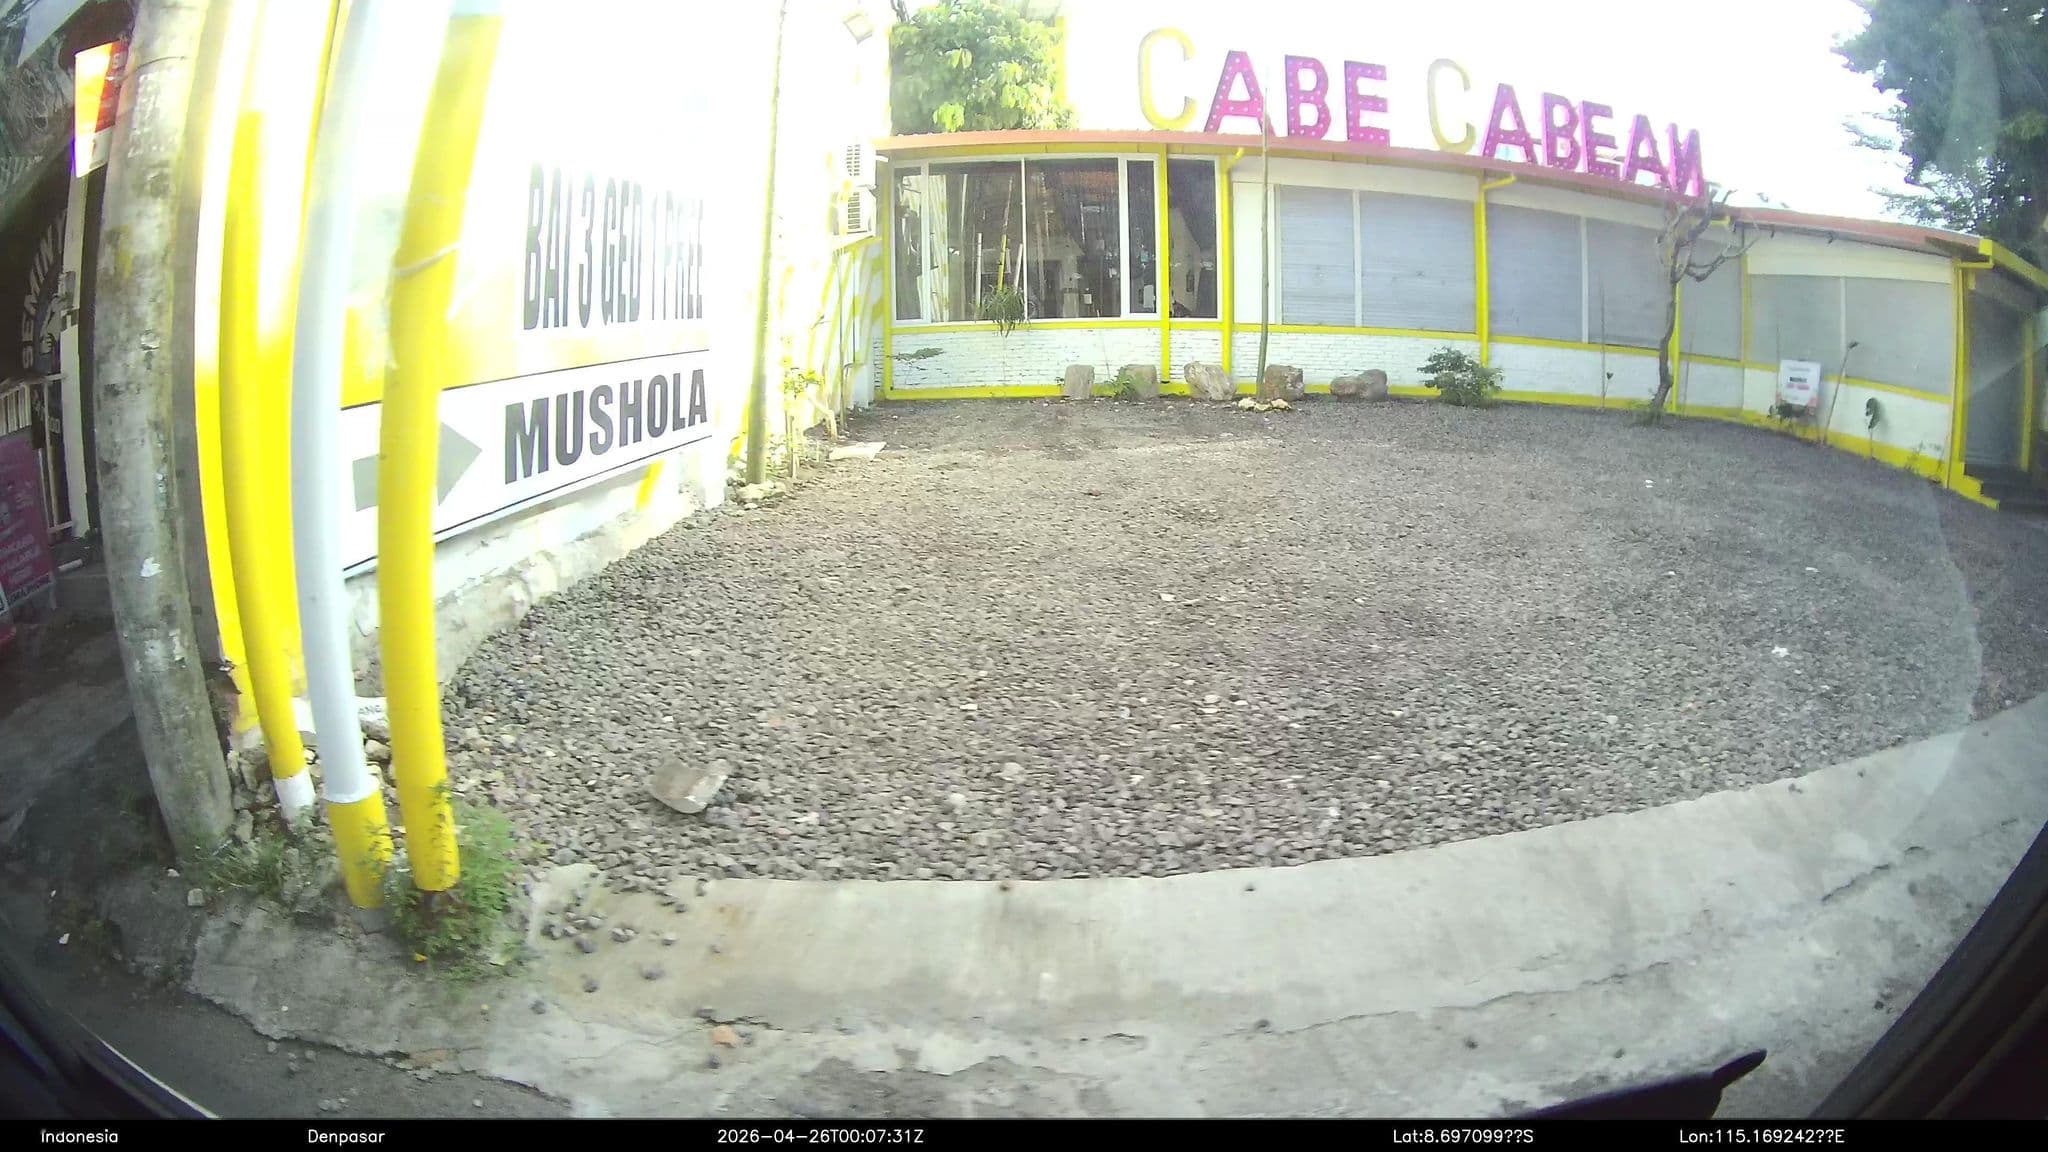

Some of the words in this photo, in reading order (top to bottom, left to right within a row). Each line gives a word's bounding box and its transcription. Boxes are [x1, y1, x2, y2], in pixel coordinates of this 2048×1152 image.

[1137, 26, 1390, 147] CABE
[578, 170, 595, 328] 3
[601, 176, 643, 325] GED
[504, 368, 708, 485] MUSHOLA
